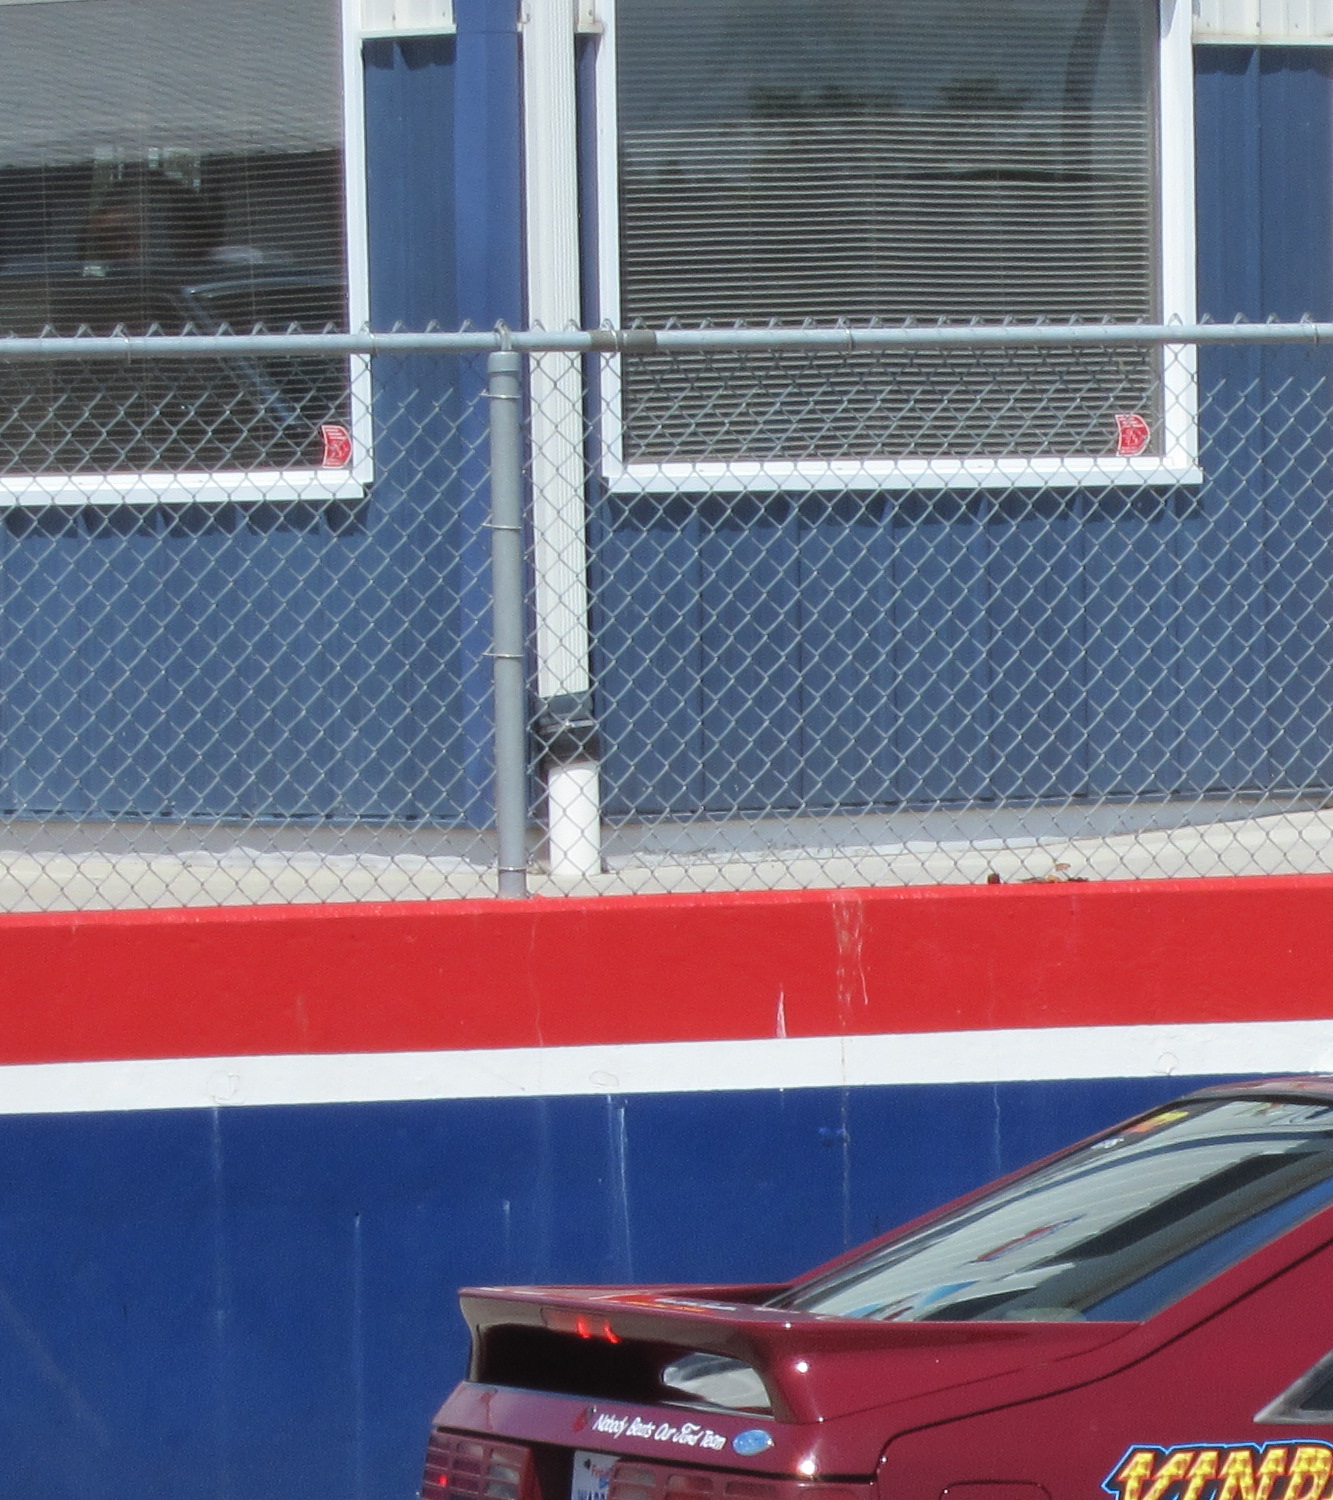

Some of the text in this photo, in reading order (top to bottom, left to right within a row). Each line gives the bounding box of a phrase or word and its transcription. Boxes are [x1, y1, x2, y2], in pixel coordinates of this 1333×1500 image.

[592, 1413, 629, 1439] Nobody
[626, 1416, 656, 1439] Beats
[673, 1422, 703, 1446] Ford
